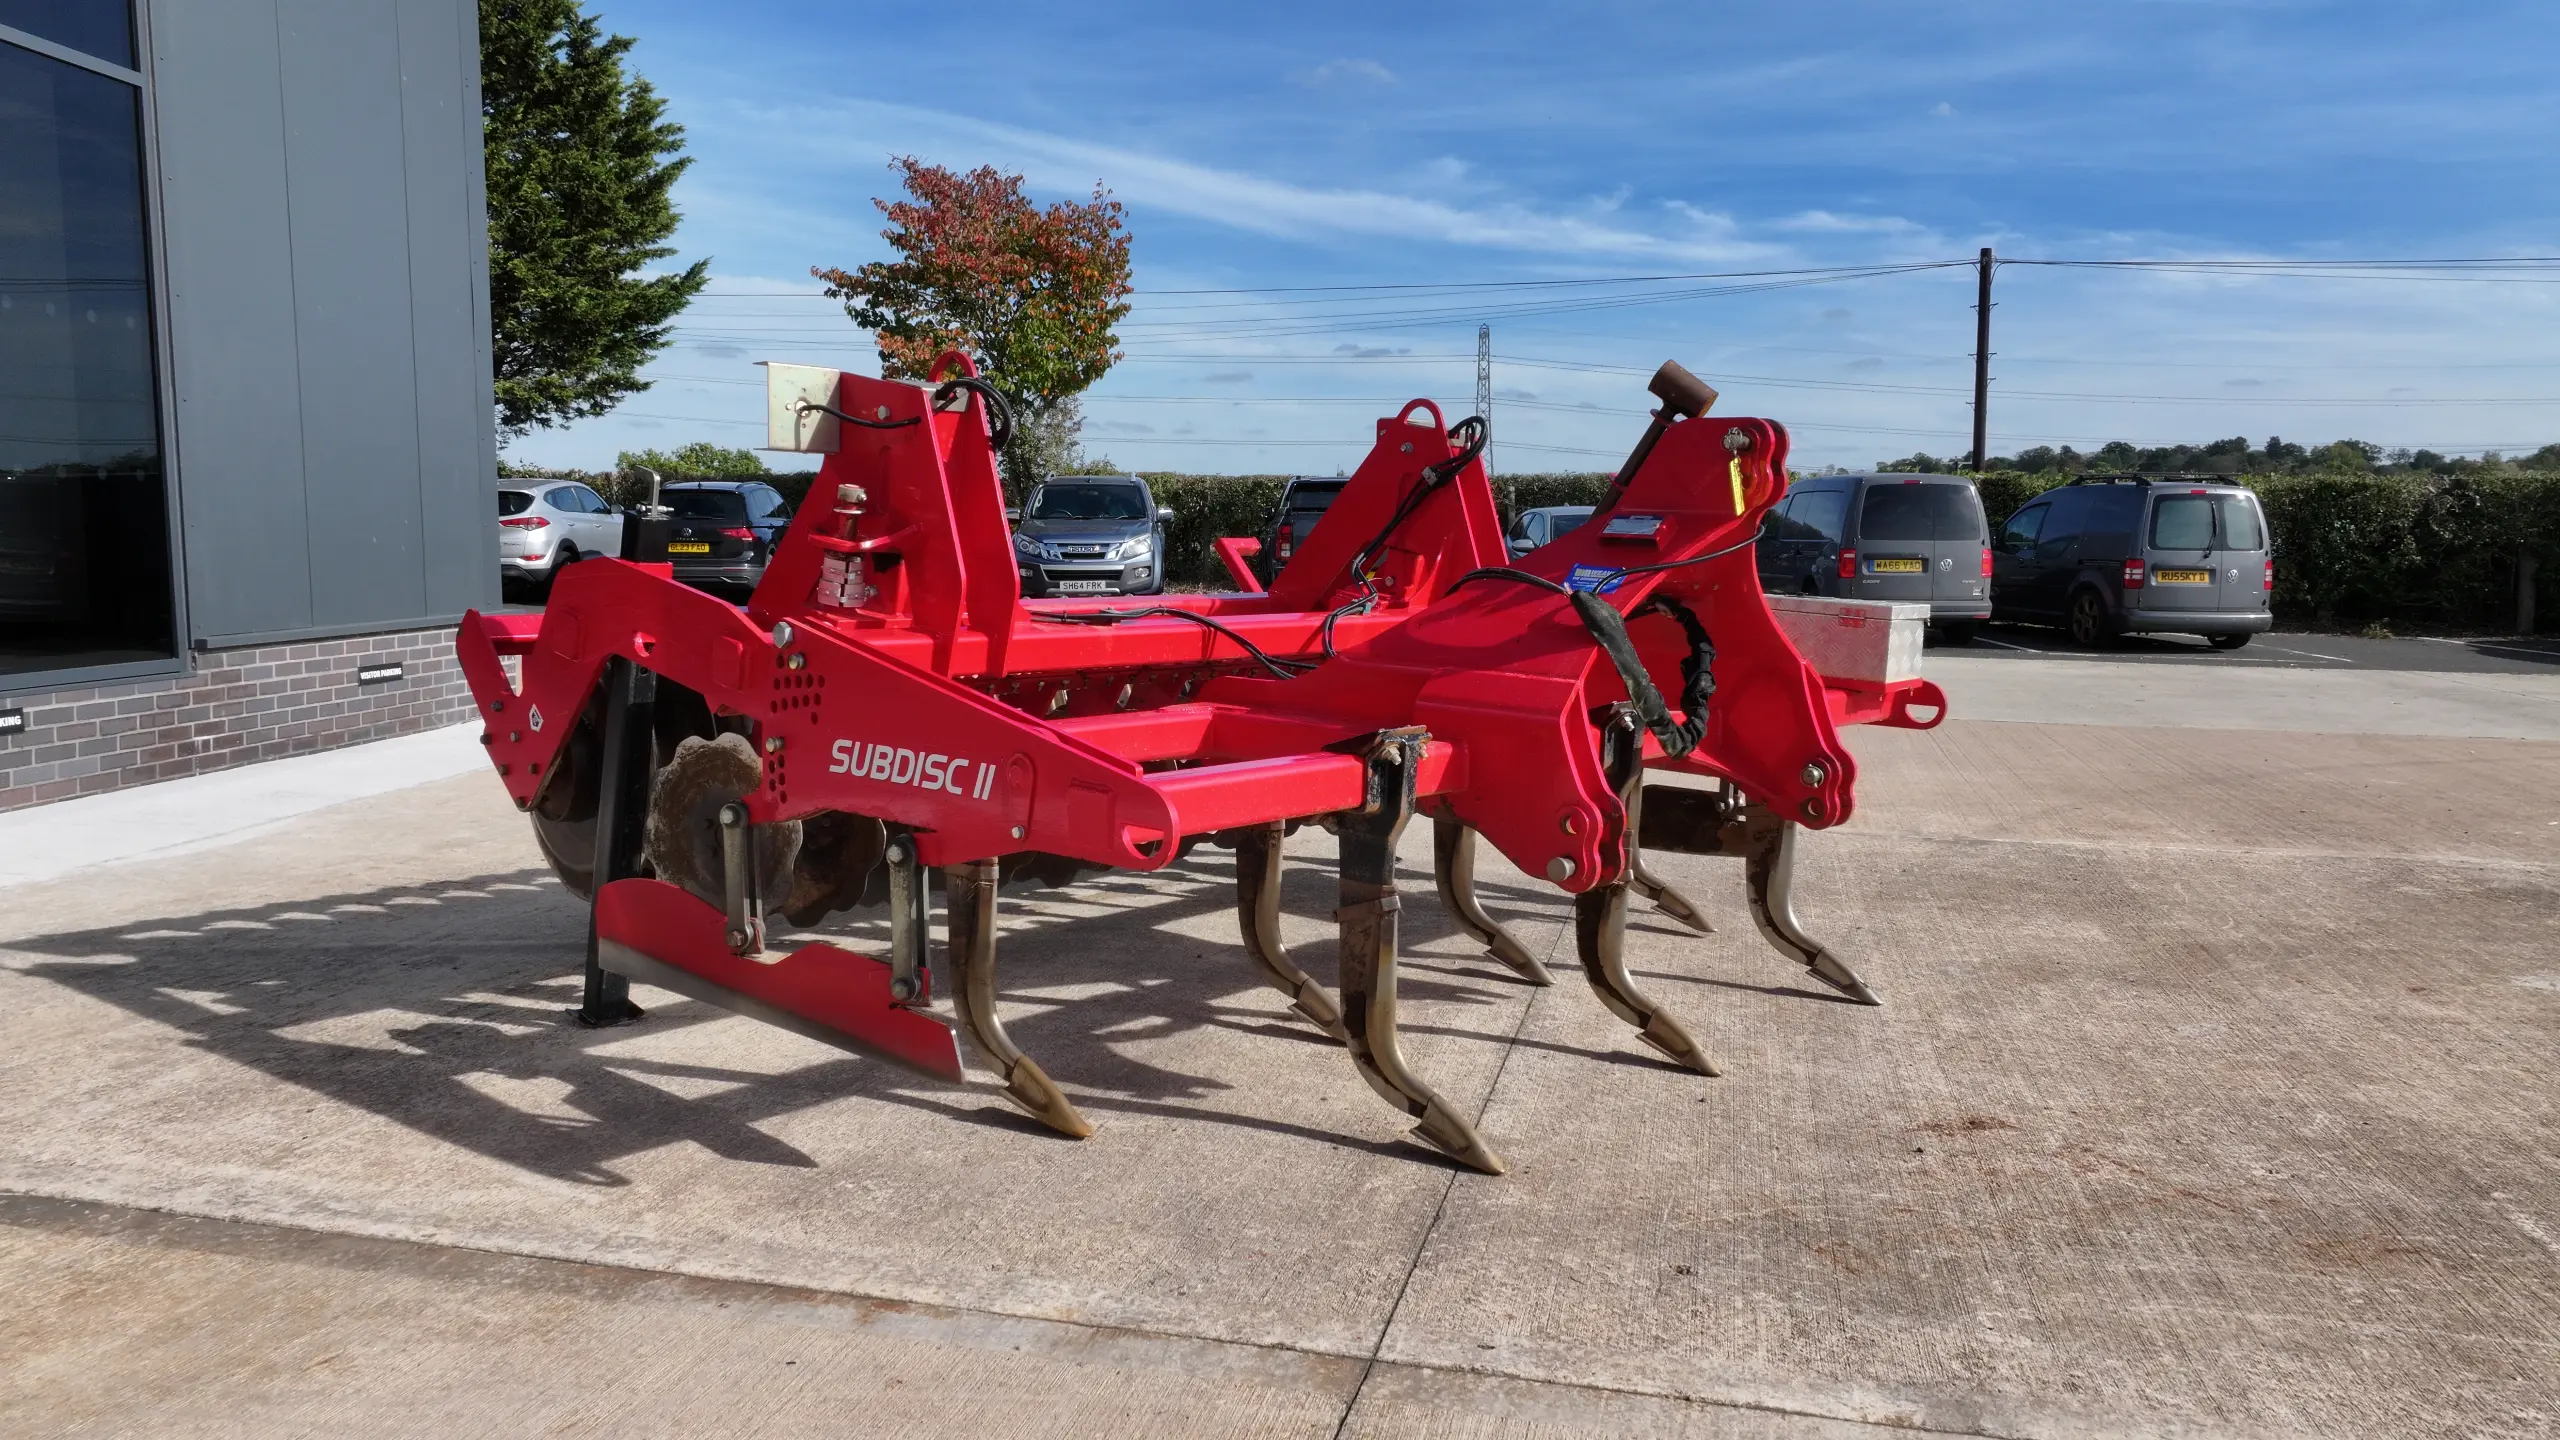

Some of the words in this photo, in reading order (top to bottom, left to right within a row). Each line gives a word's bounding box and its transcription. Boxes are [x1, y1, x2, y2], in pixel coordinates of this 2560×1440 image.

[1876, 561, 1901, 570] WA66
[1063, 582, 1084, 590] SH64
[1086, 582, 1102, 590] FRK
[360, 670, 381, 680] VISITOR
[380, 667, 402, 677] PARKING
[828, 738, 969, 795] SUBDISC
[972, 762, 996, 801] II
